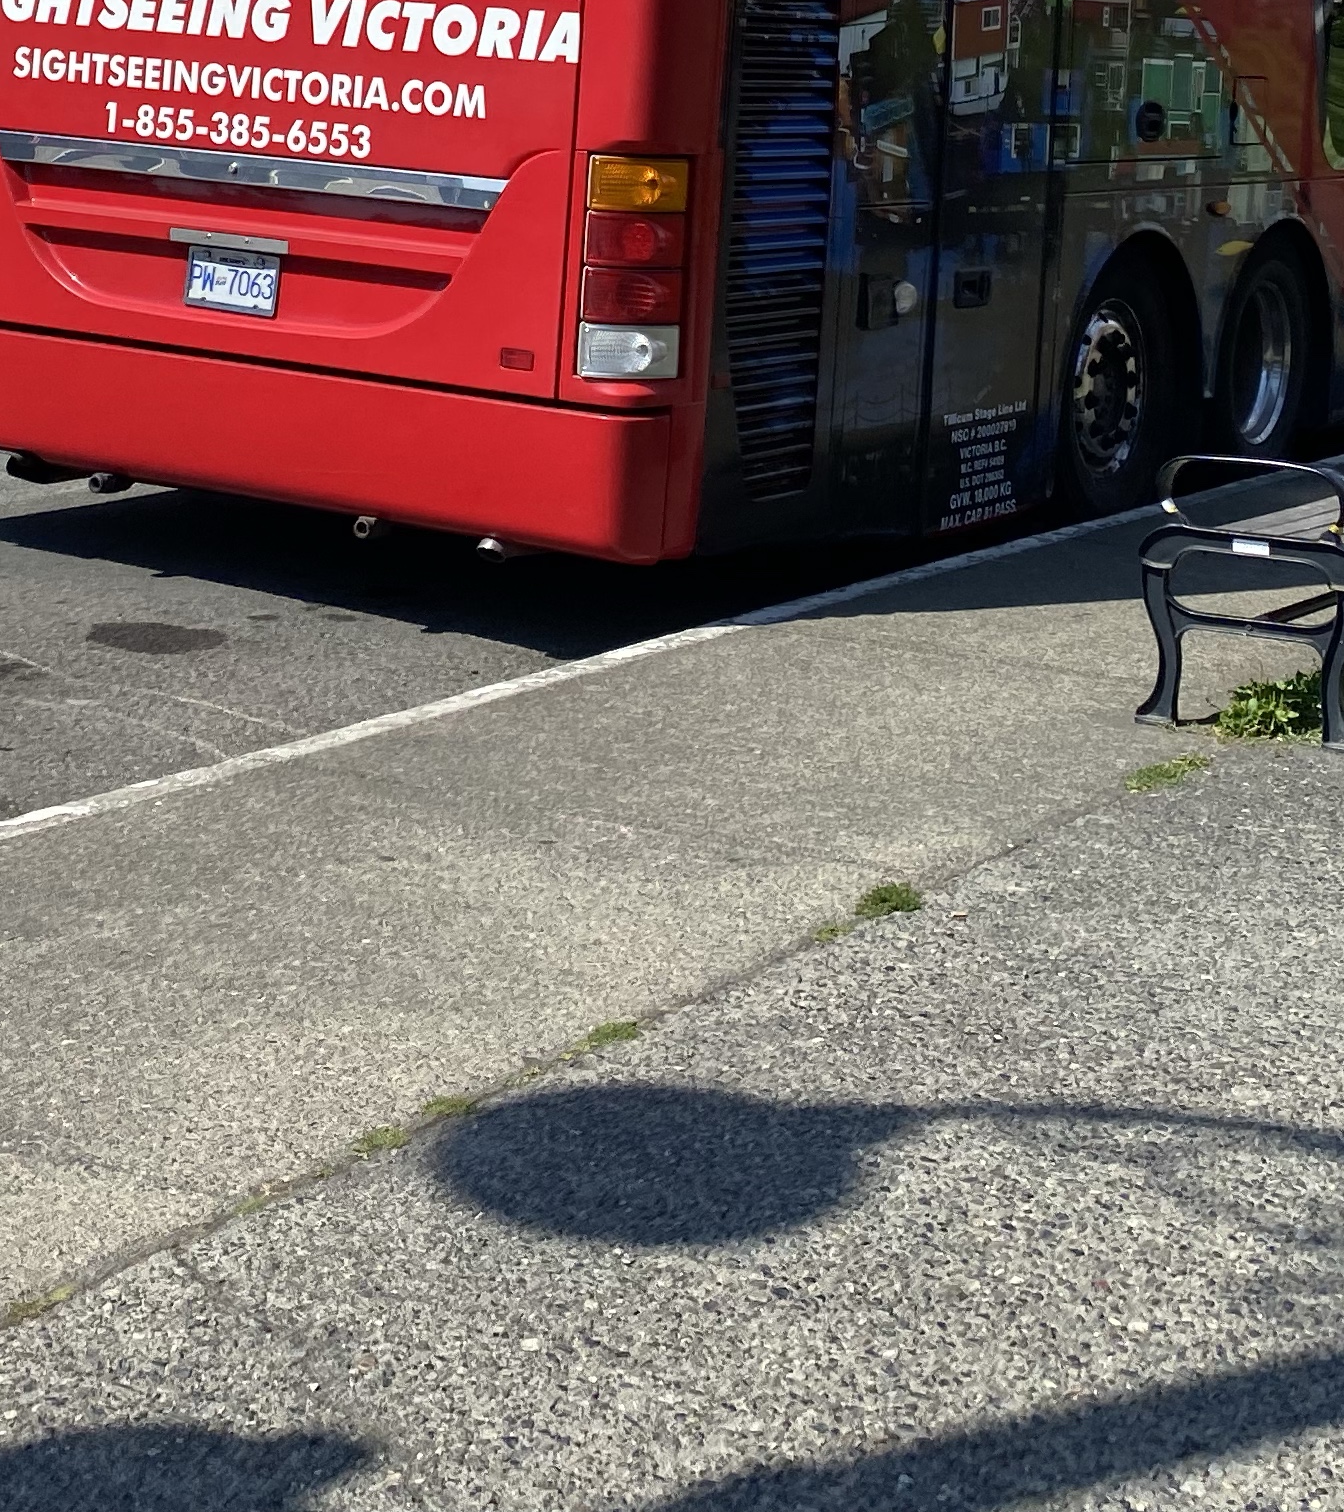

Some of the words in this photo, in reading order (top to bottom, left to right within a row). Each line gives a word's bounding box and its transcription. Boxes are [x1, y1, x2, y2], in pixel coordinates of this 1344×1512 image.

[12, 46, 487, 120] SIGHTSEEINGVICTORIA.COM
[104, 101, 373, 159] 1-855-385-6553
[191, 264, 216, 292] PW
[227, 268, 275, 300] 7063
[944, 413, 974, 426] Tillicum
[974, 407, 997, 420] Stage
[997, 404, 1014, 416] Line
[960, 442, 993, 459] VICTORIA
[1000, 481, 1012, 497] KG
[940, 513, 962, 530] MAX.
